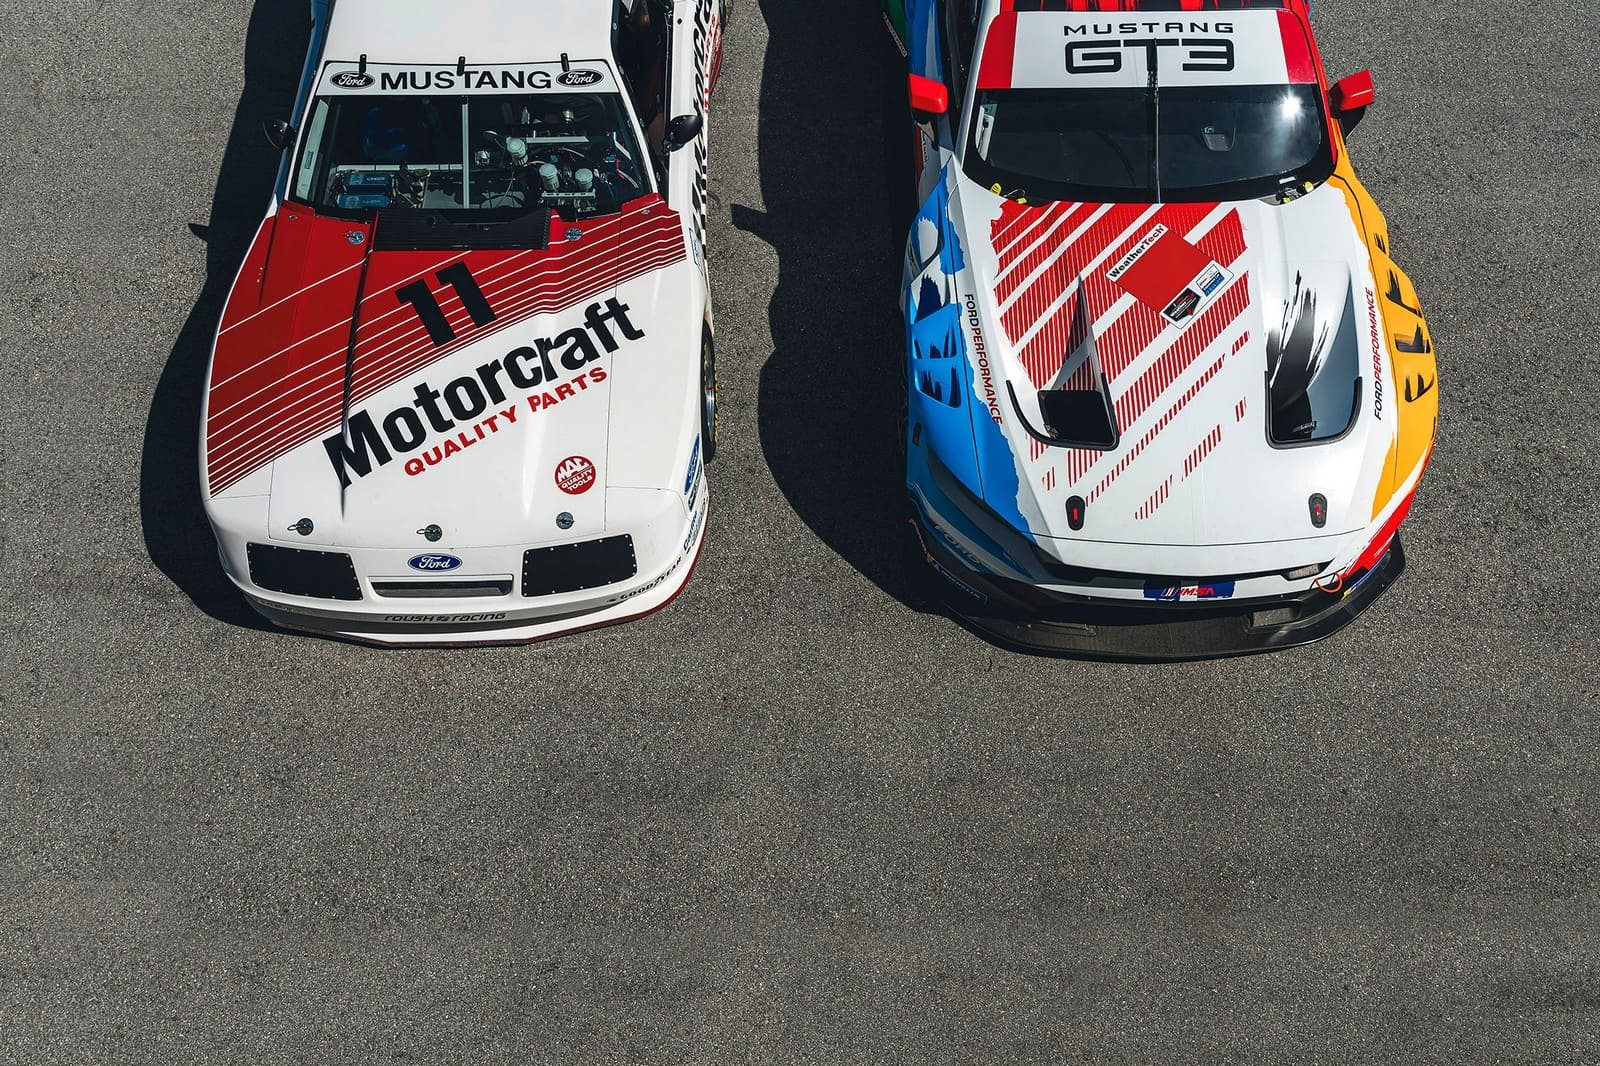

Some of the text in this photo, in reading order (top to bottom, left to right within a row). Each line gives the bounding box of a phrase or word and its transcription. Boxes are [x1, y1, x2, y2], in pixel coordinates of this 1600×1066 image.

[1064, 22, 1233, 36] MUSTANG
[1065, 38, 1235, 75] GT3
[337, 70, 595, 90] Ford MUSTANG Ford
[395, 261, 497, 348] 11
[322, 297, 645, 489] Motorcraft
[404, 367, 607, 476] QUALITY PARTS
[557, 457, 590, 482] MAC
[561, 468, 592, 488] QUALITY
[568, 475, 593, 491] TOOLS
[417, 554, 453, 570] Ford
